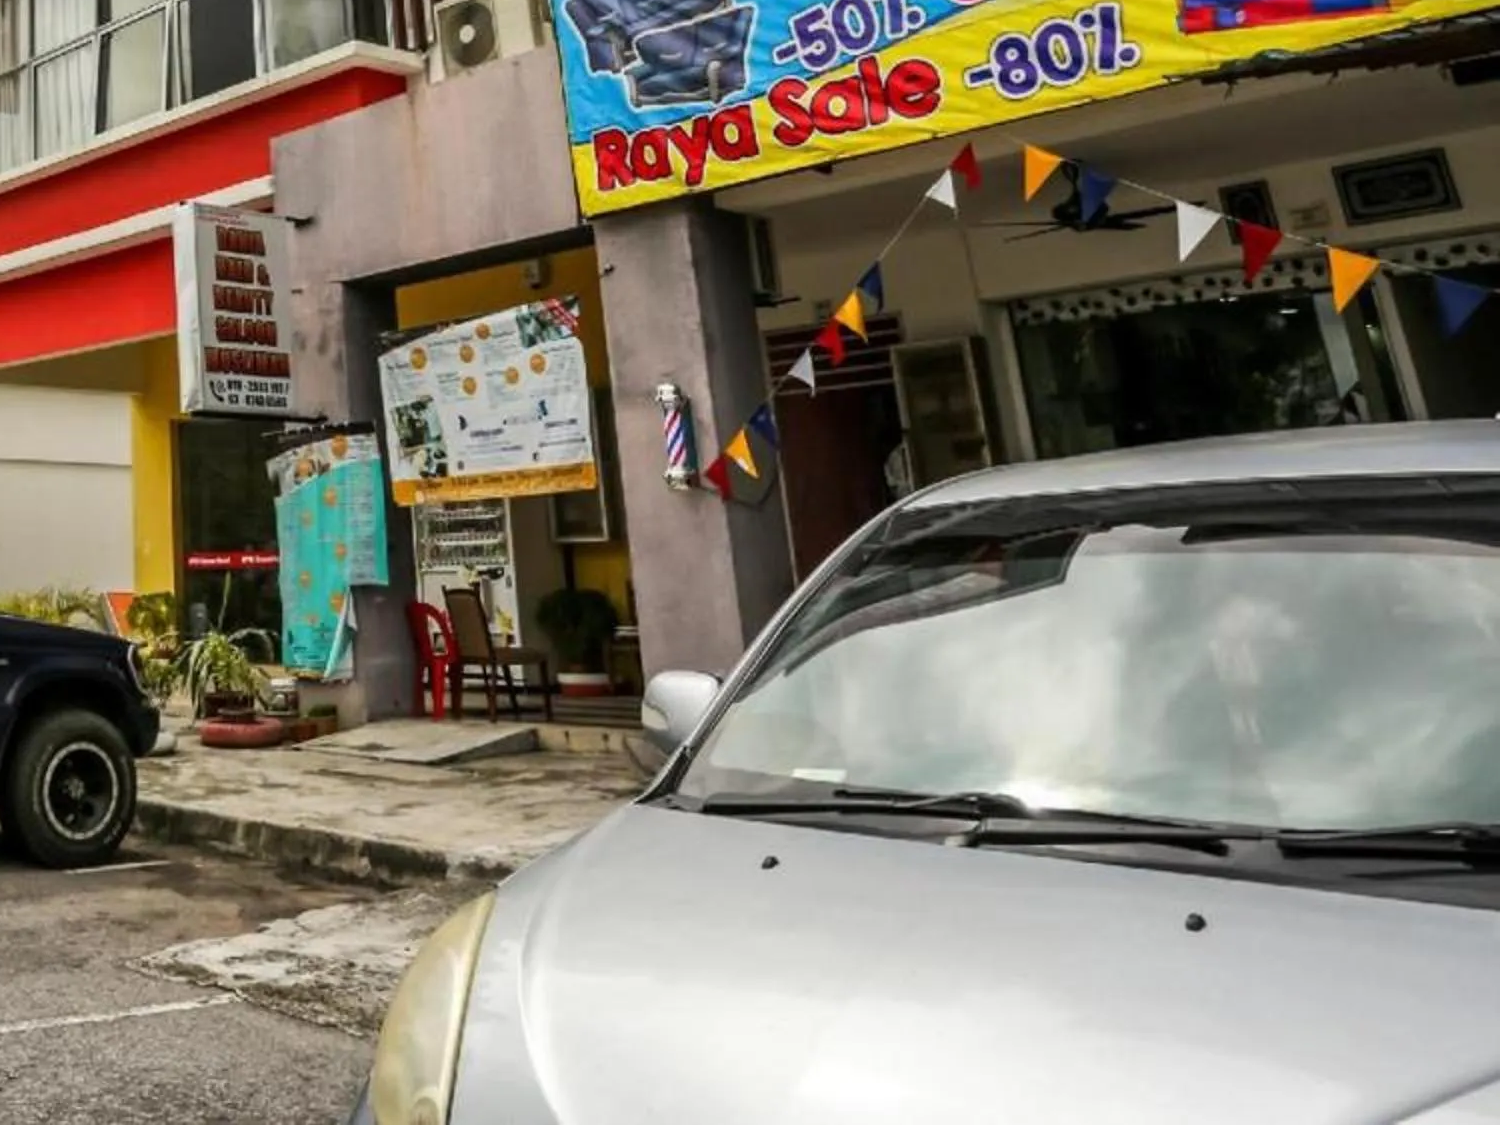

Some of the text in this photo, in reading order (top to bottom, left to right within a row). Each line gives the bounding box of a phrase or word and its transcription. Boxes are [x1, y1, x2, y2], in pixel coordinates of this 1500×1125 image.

[964, 1, 1141, 99] -80%
[593, 55, 942, 192] Raya Sale
